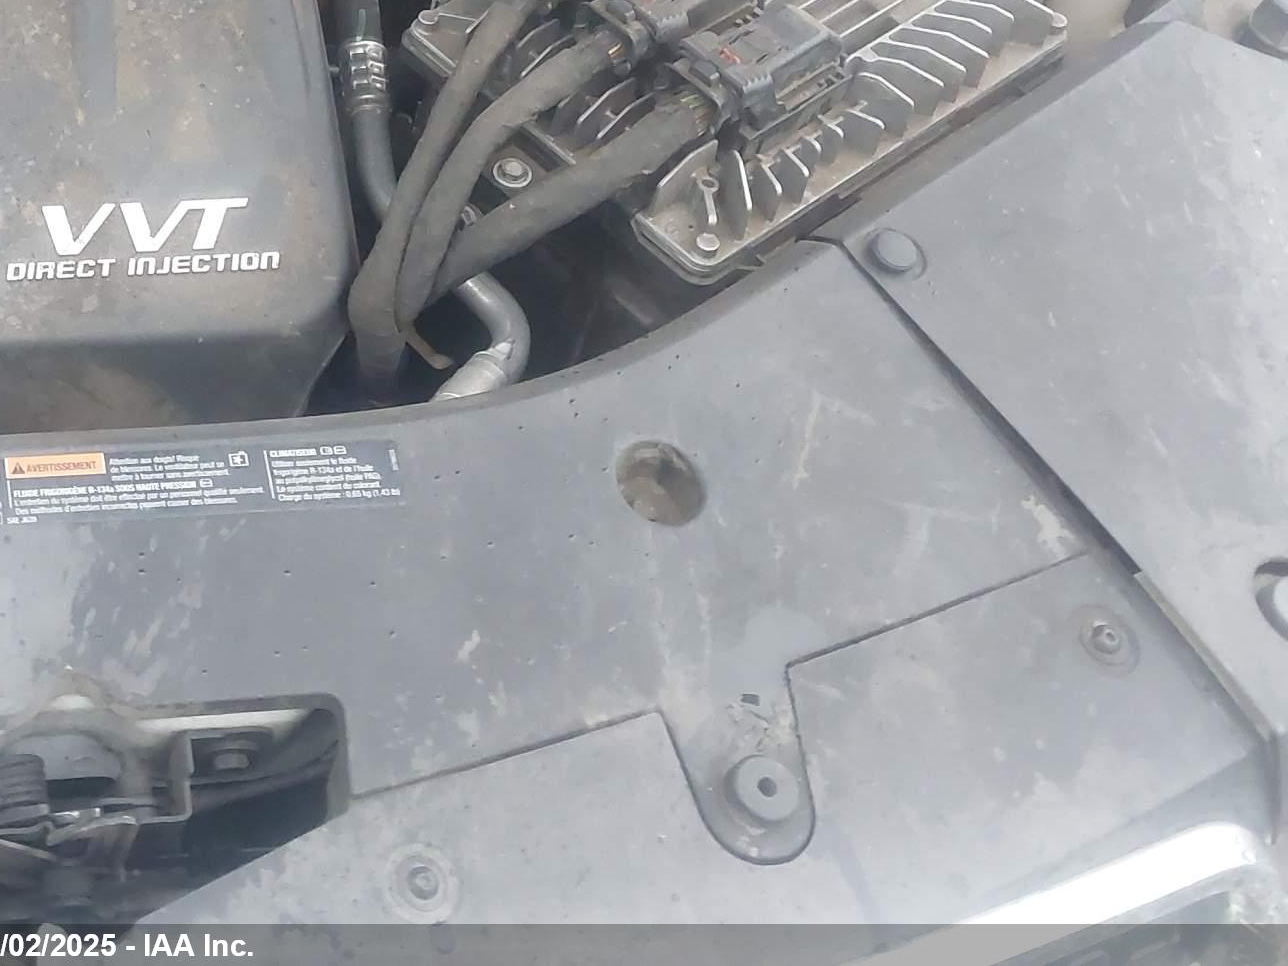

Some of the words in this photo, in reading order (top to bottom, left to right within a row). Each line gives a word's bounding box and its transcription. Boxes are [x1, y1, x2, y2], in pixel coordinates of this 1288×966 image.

[41, 197, 249, 256] VVT
[6, 257, 116, 282] DIRECT
[127, 251, 281, 277] INJECTION
[27, 461, 96, 472] AVERTISSEMENT
